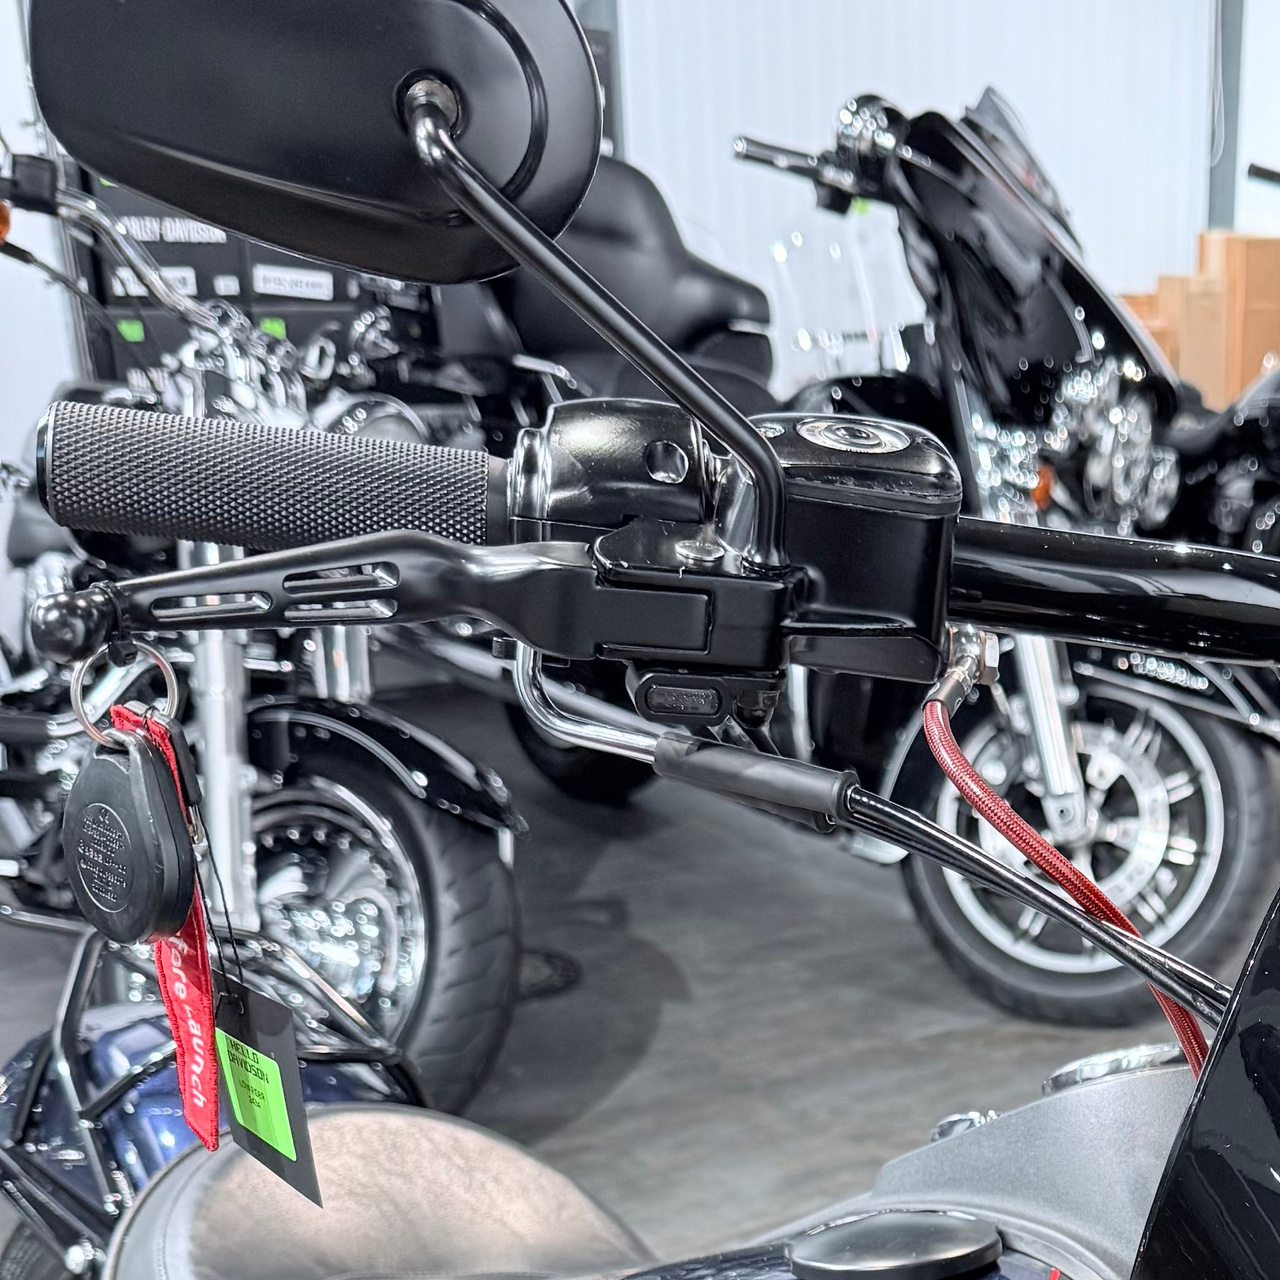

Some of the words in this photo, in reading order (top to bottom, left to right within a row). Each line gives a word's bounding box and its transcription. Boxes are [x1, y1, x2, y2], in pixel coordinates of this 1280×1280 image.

[168, 936, 193, 999] fore
[183, 1003, 208, 1108] Launch
[227, 1049, 269, 1084] DAVIDSON
[228, 1039, 259, 1064] HELLO
